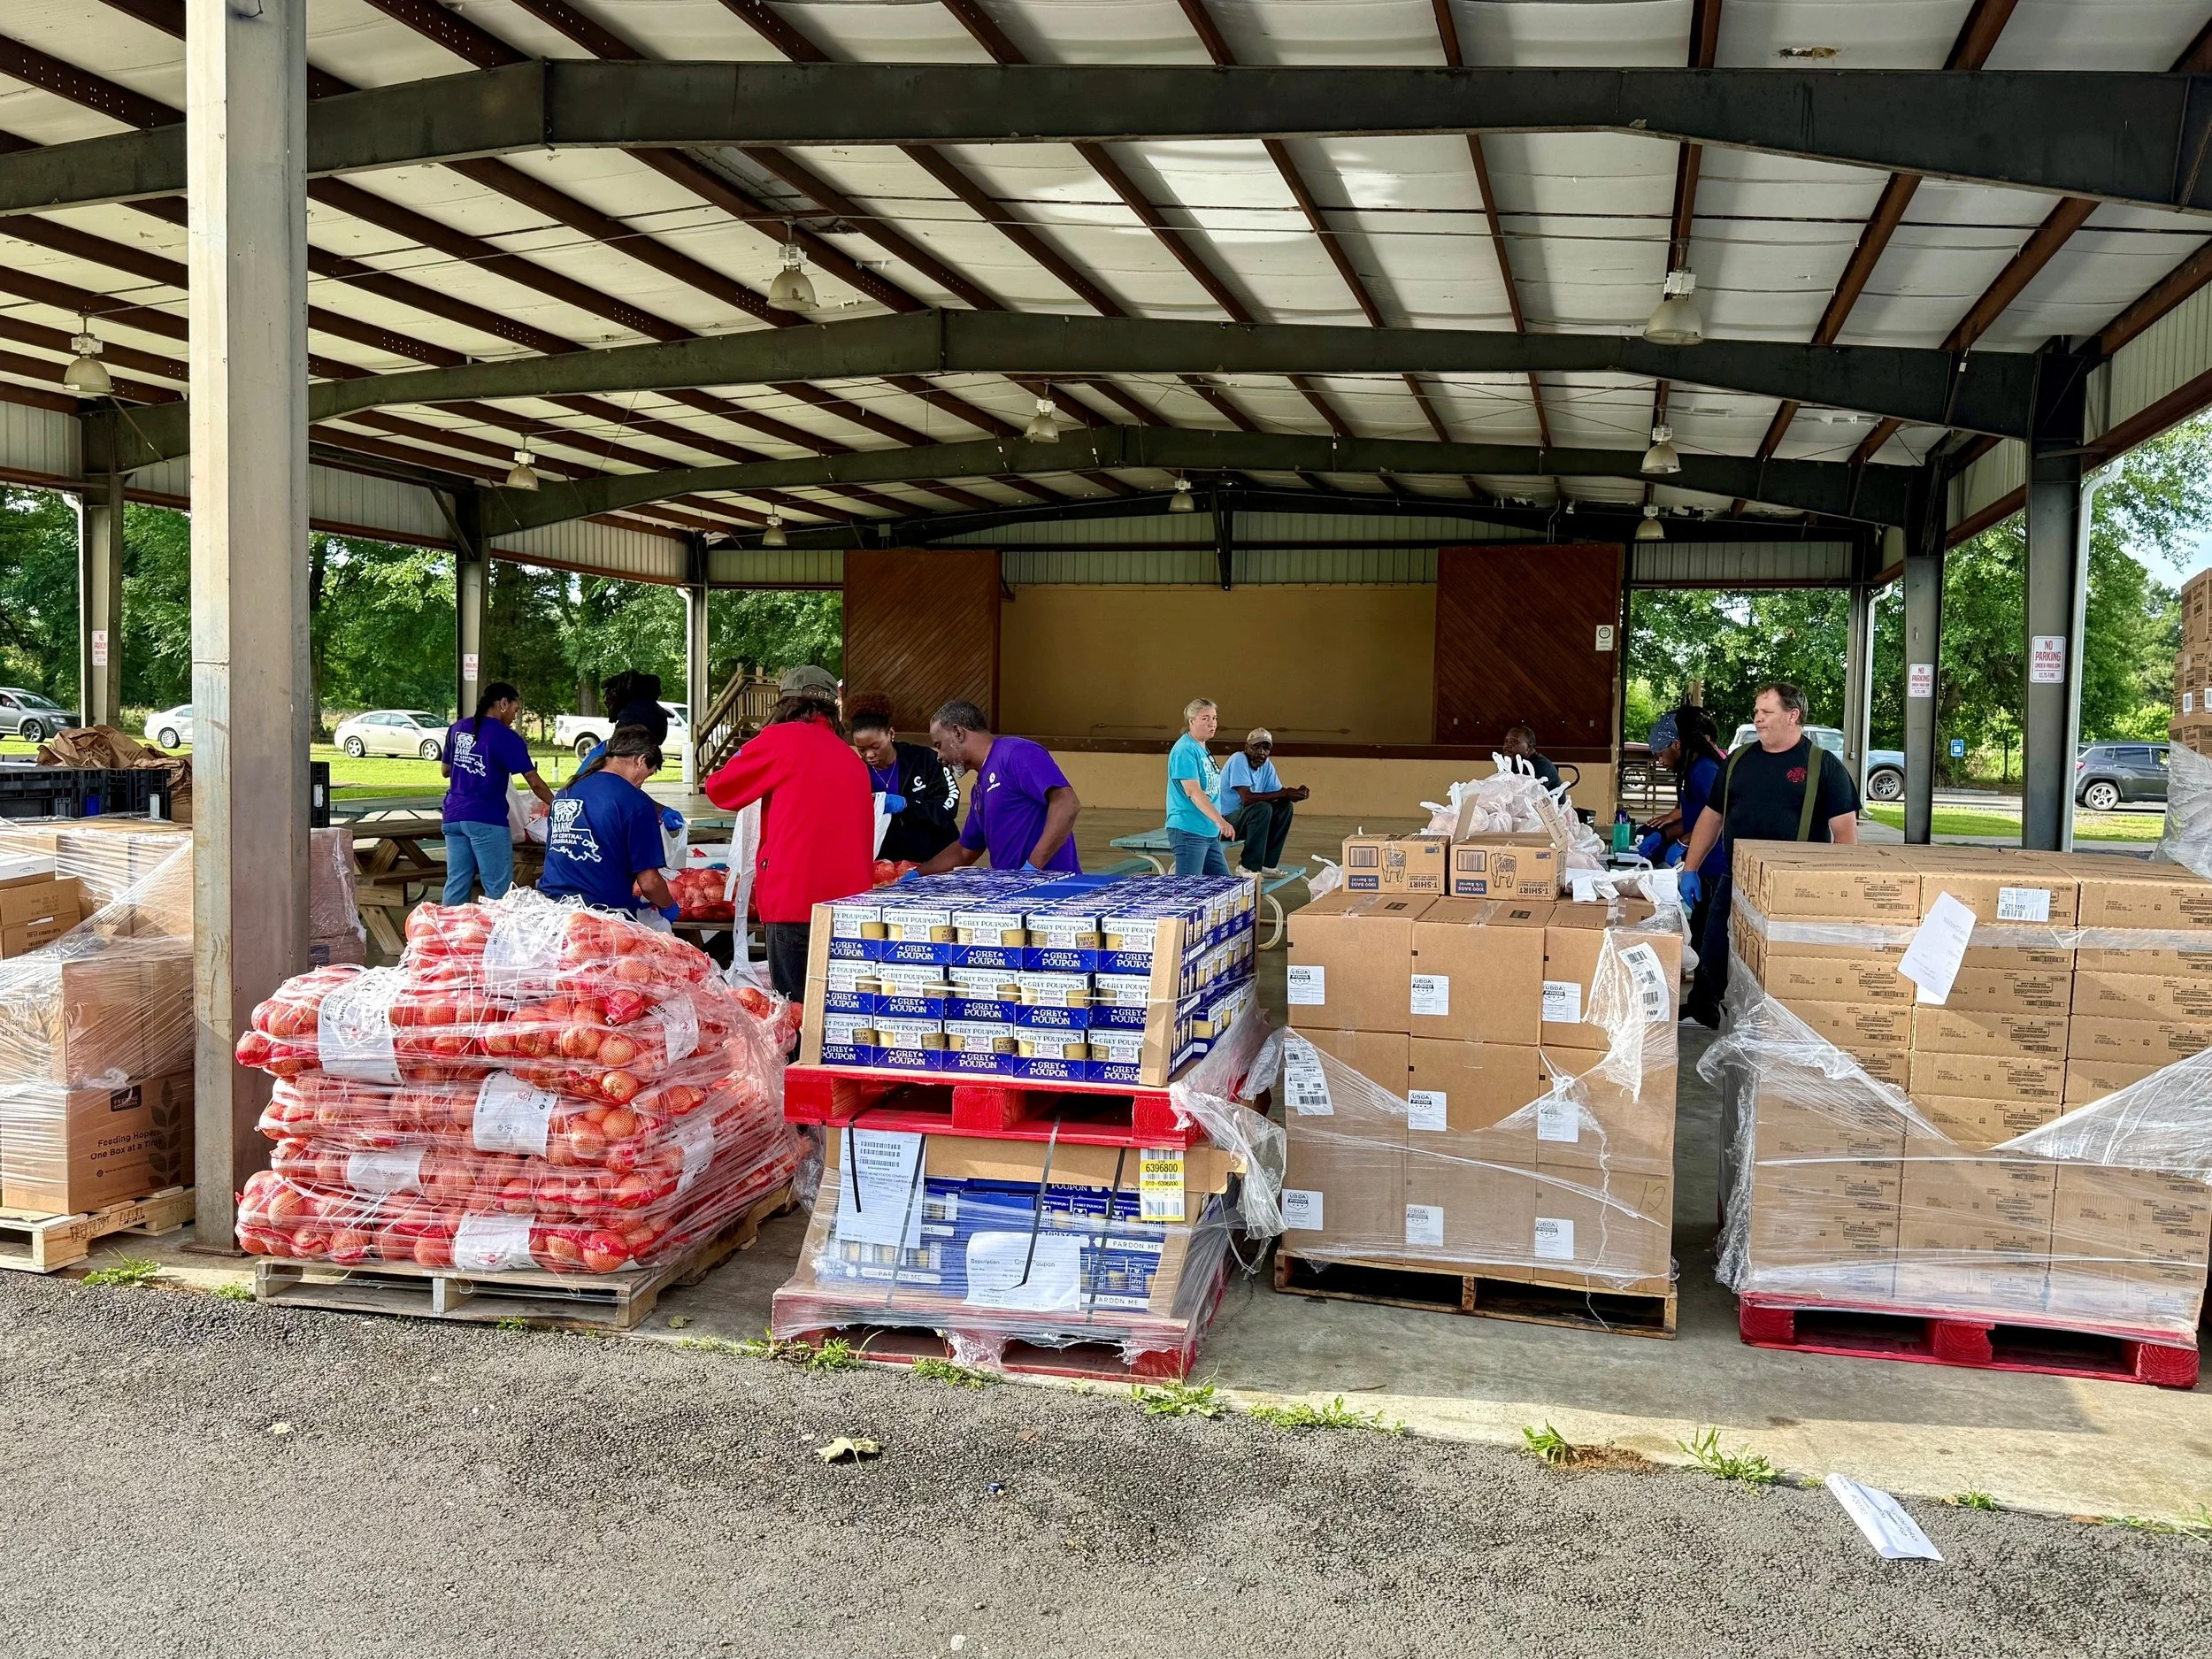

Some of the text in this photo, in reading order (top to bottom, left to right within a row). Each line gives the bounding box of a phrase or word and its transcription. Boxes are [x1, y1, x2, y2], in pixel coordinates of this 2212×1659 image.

[2045, 641, 2053, 650] NO
[2035, 651, 2061, 661] PARKING
[897, 951, 934, 960] POUPON
[968, 957, 1005, 966] POUPON
[1042, 958, 1080, 967] POUPON
[890, 1005, 927, 1013] POUPON
[964, 1009, 1002, 1018] POUPON
[1032, 1016, 1070, 1025] POUPON
[888, 1056, 925, 1065] POUPON
[959, 1060, 997, 1068] POUPON
[1030, 1068, 1068, 1077] POUPON
[98, 1135, 131, 1147] Feeding
[91, 1151, 107, 1160] One
[110, 1147, 125, 1156] Box
[1146, 1164, 1178, 1172] 6396800
[1639, 1181, 1670, 1217] 12
